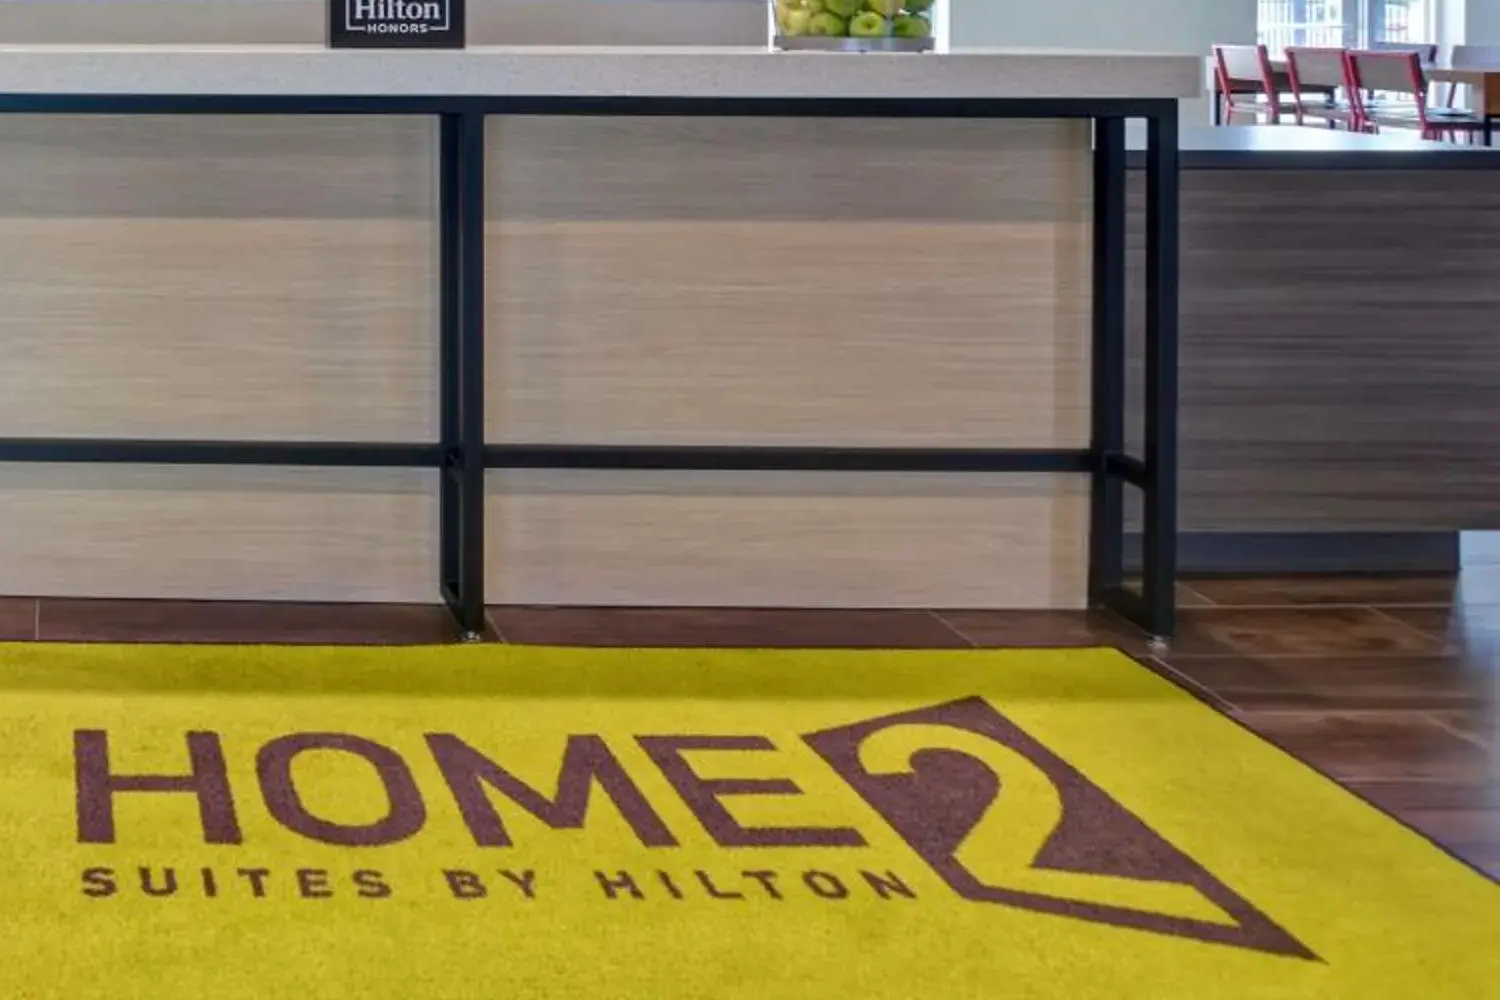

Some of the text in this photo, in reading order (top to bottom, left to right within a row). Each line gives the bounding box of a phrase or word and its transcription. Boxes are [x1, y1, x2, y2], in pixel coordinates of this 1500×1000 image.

[366, 22, 429, 34] HONORS
[81, 866, 918, 901] SUITES BY HILTON
